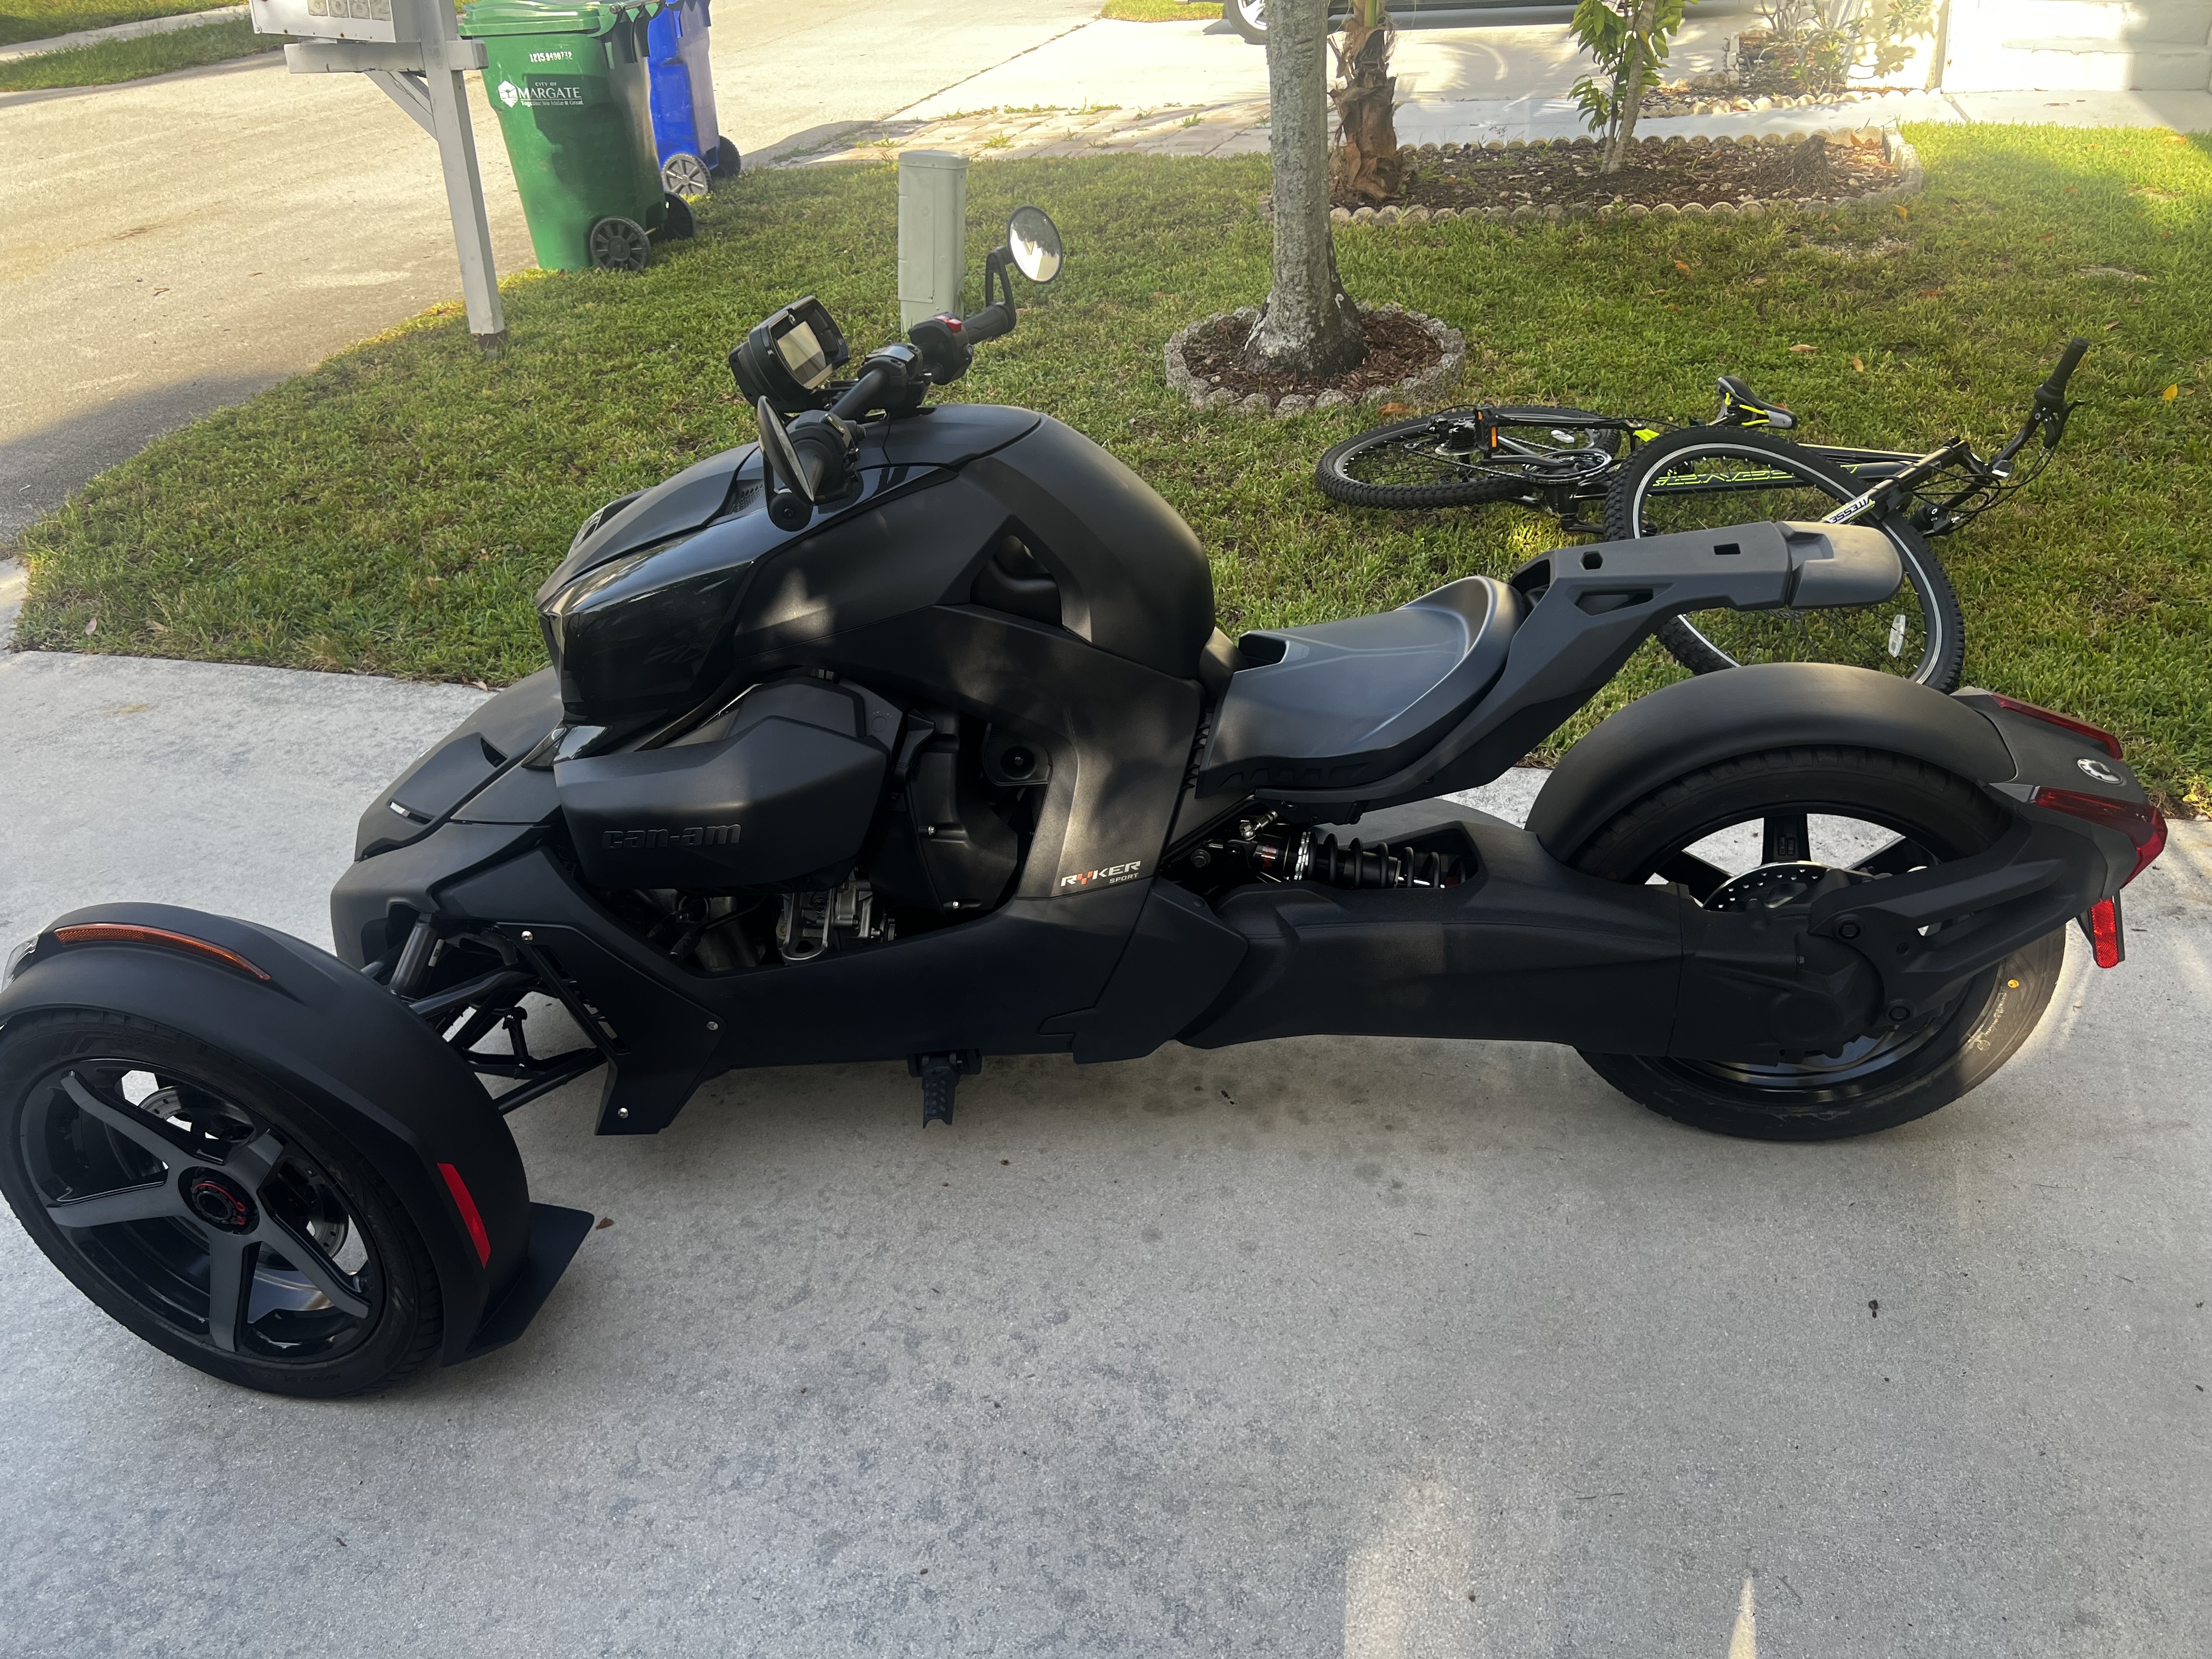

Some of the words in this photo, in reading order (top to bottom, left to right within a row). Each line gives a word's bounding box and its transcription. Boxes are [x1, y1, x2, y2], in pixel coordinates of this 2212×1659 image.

[517, 87, 582, 99] MARGATE
[603, 824, 741, 848] can-am
[1060, 860, 1142, 887] RYKER
[1109, 872, 1139, 884] SPORT
